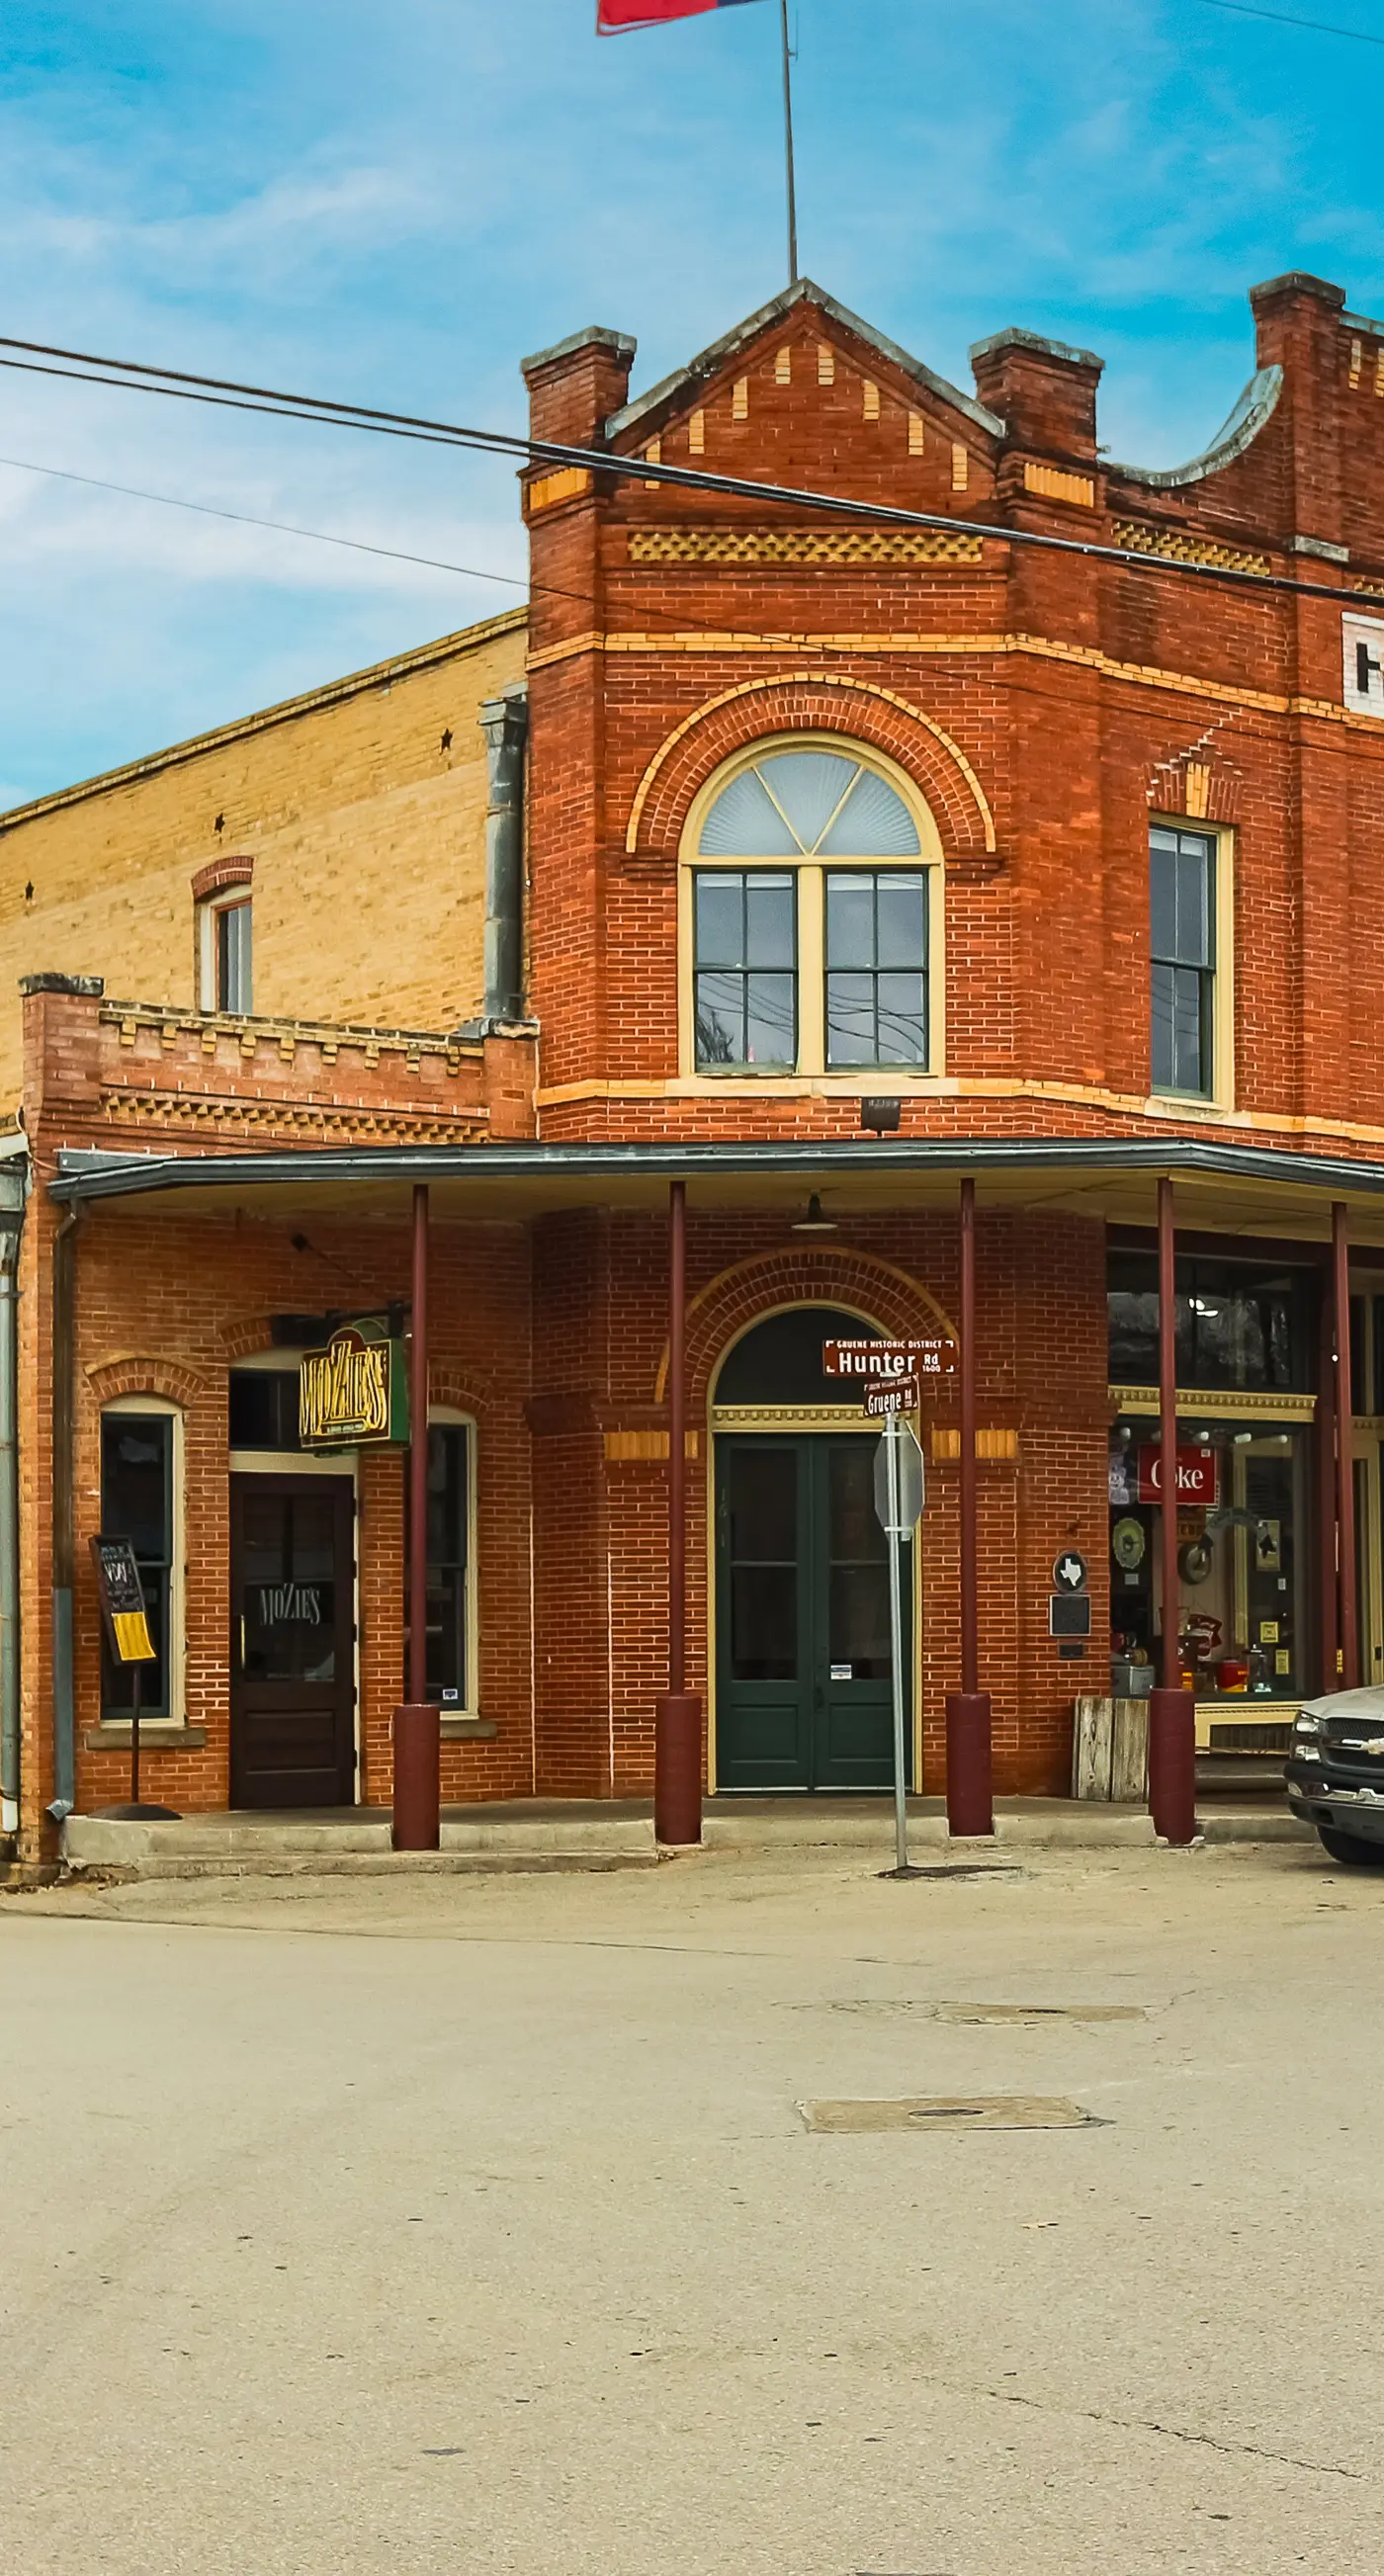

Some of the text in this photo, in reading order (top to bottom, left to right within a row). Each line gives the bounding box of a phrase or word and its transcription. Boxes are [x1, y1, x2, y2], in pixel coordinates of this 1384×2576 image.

[838, 1352, 938, 1373] Hunter Rd
[867, 1392, 902, 1415] Gruene
[1151, 1459, 1204, 1490] Cke
